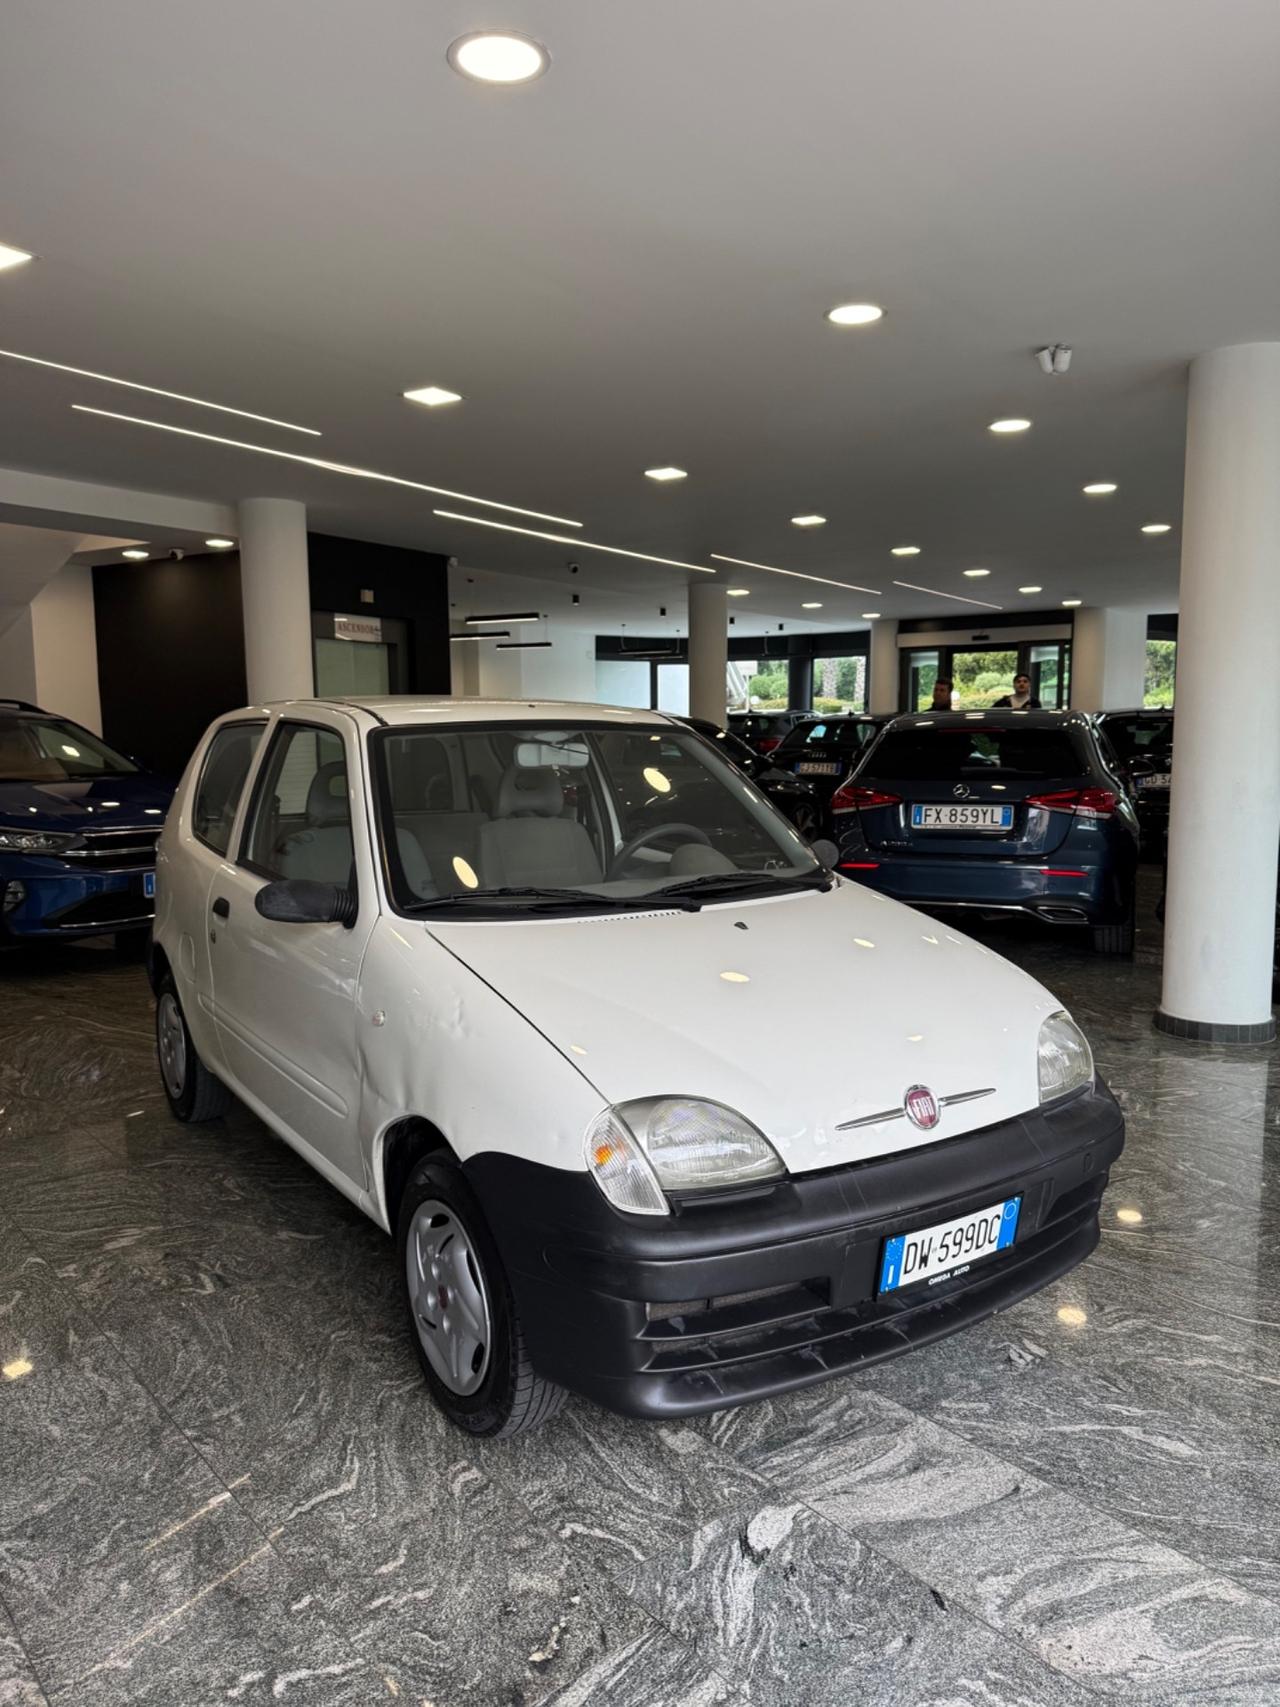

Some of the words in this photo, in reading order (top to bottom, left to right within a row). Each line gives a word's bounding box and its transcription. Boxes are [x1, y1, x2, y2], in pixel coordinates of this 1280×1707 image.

[924, 808, 942, 823] FX
[949, 808, 999, 824] 859YL
[911, 1096, 935, 1119] FIAT
[904, 1236, 933, 1275] DW
[937, 1214, 1001, 1263] 599DC
